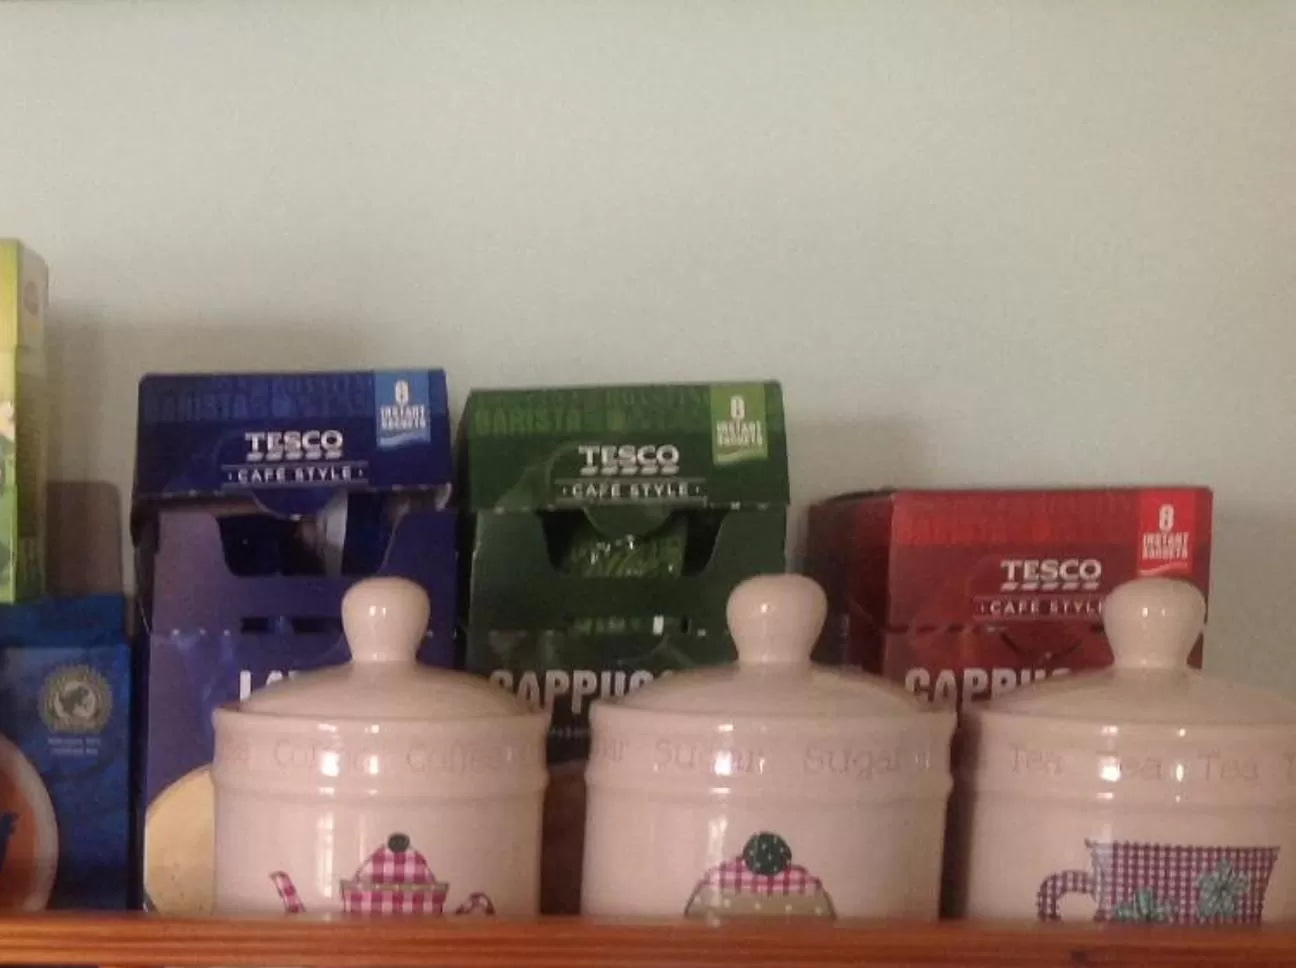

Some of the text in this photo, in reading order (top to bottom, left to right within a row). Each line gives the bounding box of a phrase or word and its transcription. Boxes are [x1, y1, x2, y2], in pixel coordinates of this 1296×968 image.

[245, 430, 344, 452] TESCO
[578, 444, 680, 466] TESCO
[1159, 504, 1174, 531] 8
[1000, 559, 1102, 581] TESCO
